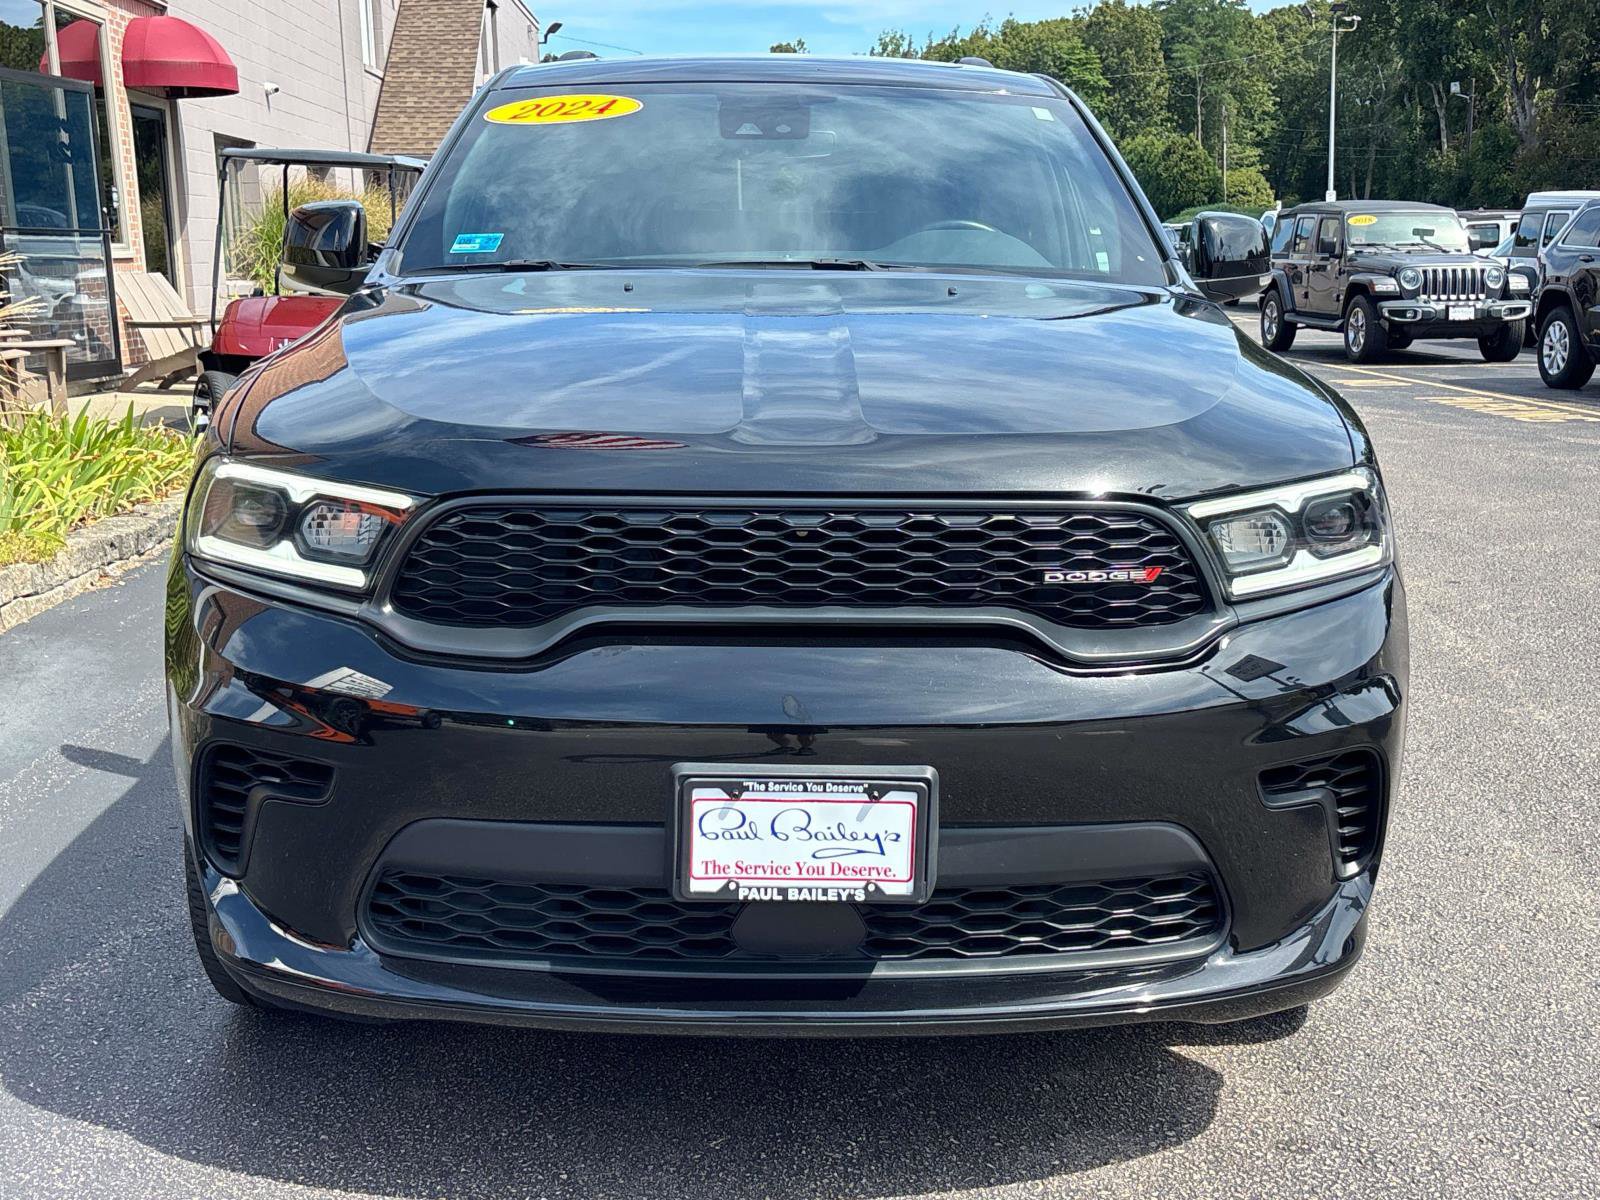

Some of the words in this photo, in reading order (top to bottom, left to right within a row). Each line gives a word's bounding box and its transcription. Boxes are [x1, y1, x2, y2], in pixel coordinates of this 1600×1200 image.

[508, 99, 618, 120] 2024
[1044, 570, 1147, 583] DODGE
[767, 782, 804, 792] Service
[806, 783, 824, 793] You
[698, 806, 765, 841] Paul
[770, 808, 901, 859] Bailey's
[701, 860, 731, 876] The
[734, 860, 791, 876] Service
[794, 861, 825, 877] You
[830, 861, 896, 878] Deserve.
[738, 887, 783, 901] PAUL
[787, 888, 866, 902] BAILEY'S
